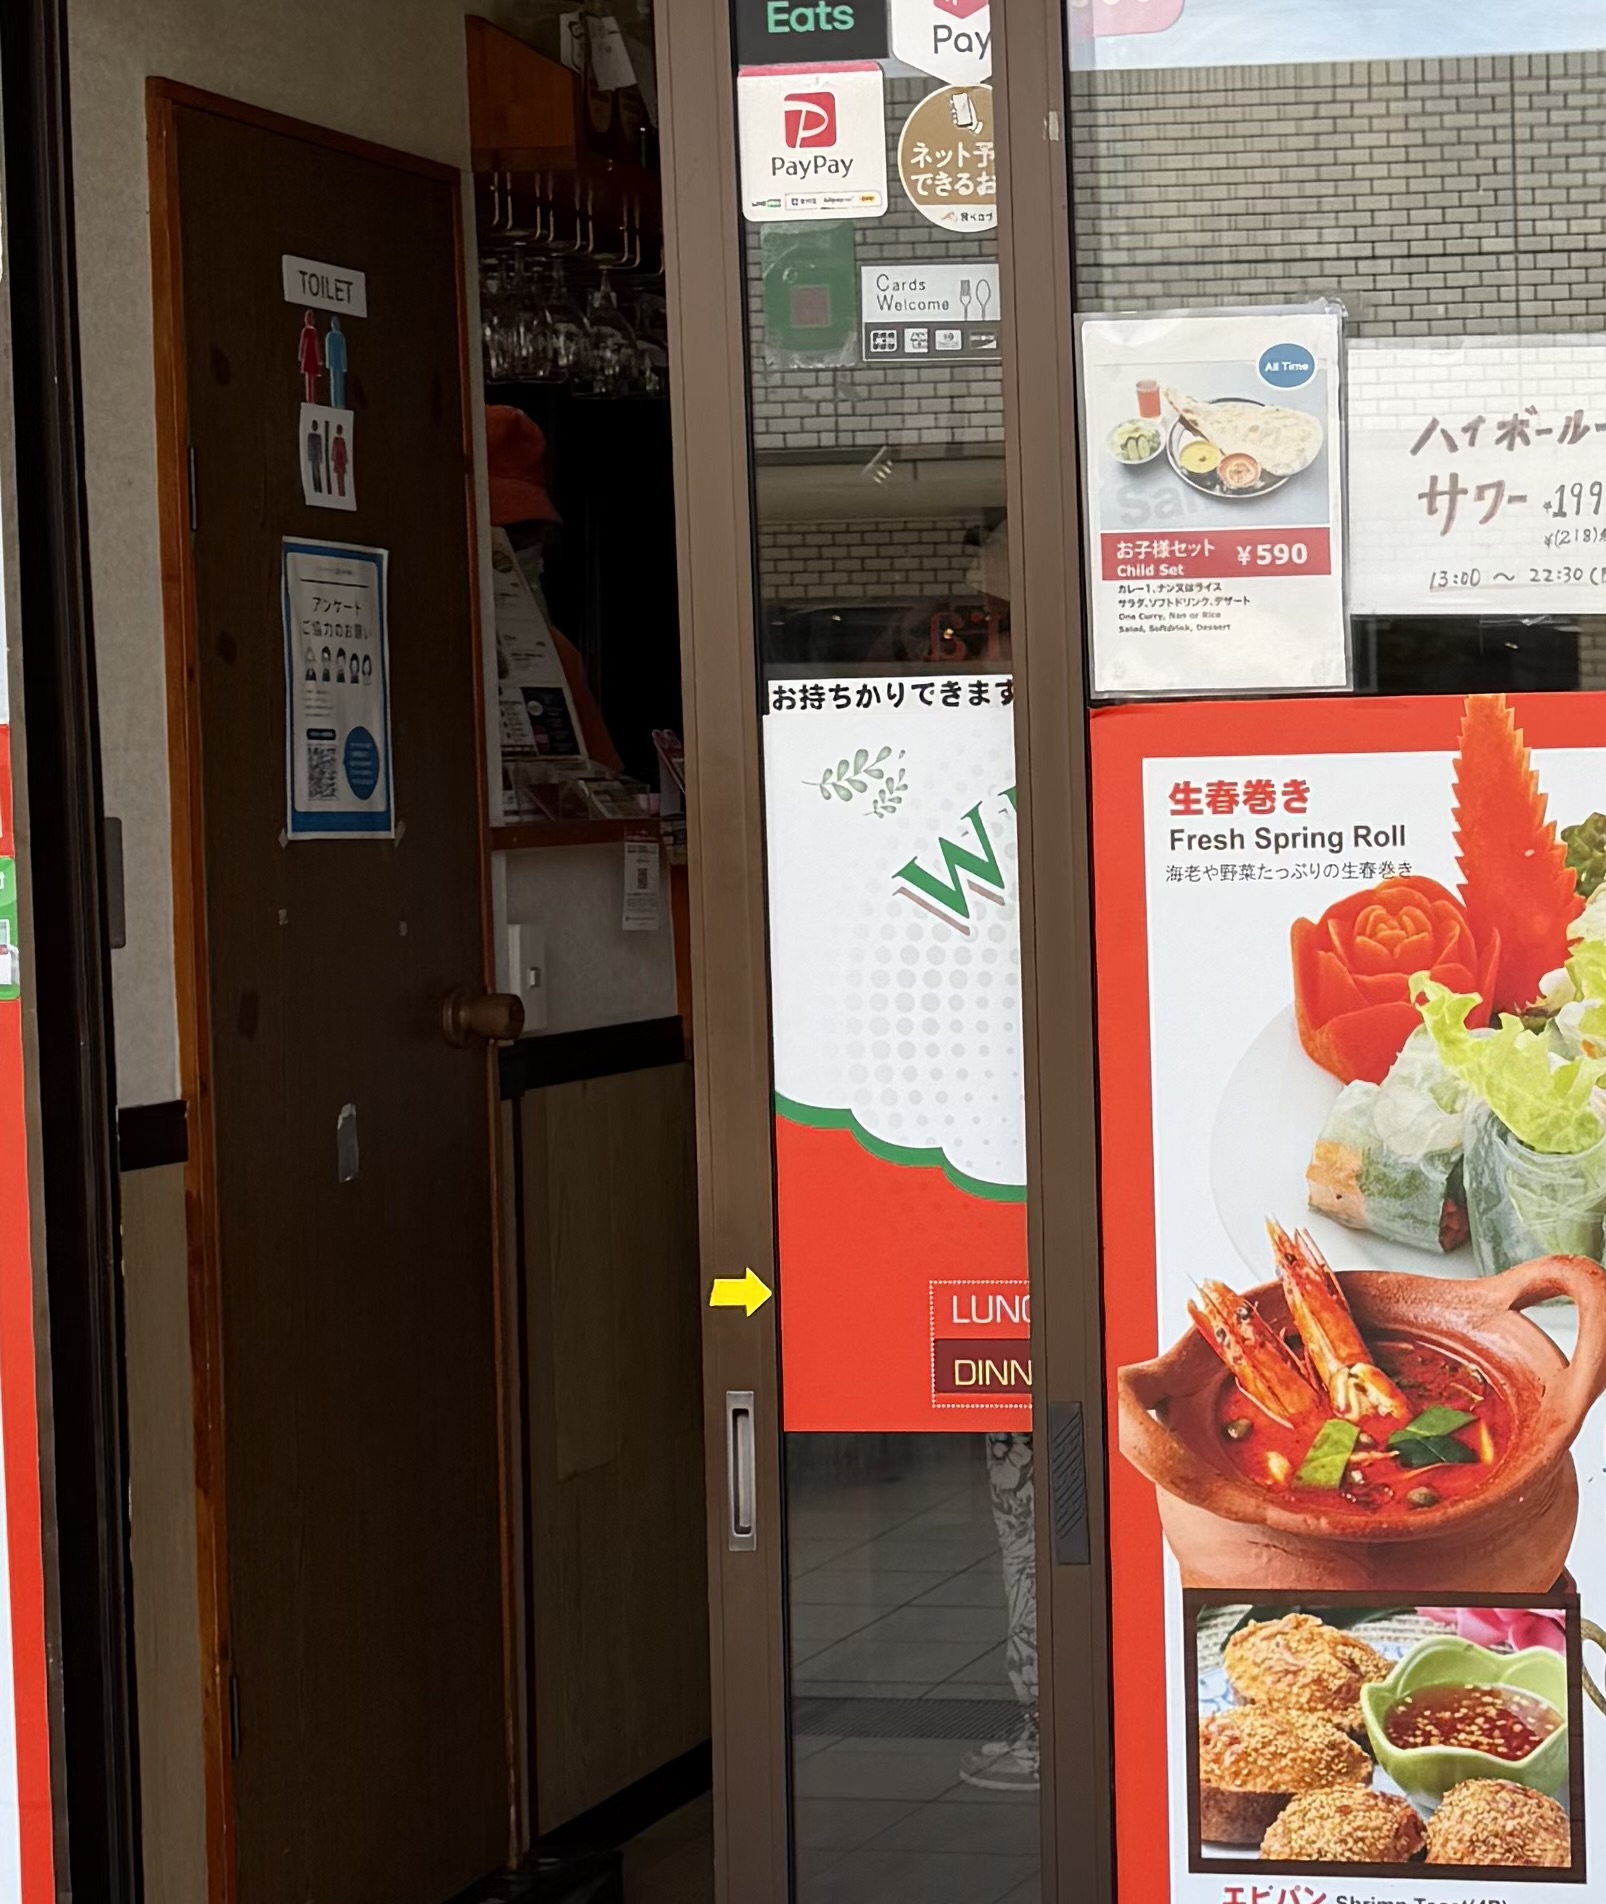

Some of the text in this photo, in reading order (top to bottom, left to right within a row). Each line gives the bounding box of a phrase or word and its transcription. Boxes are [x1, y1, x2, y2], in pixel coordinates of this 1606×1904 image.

[766, 0, 856, 34] Eats
[933, 24, 991, 61] Pay
[771, 155, 854, 180] PayPay
[298, 269, 354, 304] TOILET
[875, 273, 926, 292] Cards
[875, 294, 950, 312] Welcome
[1116, 538, 1308, 566] お子様セット ¥590
[1116, 563, 1185, 577] Child Set
[1168, 778, 1311, 817] 生春巻き
[1170, 824, 1406, 854] Fresh Spring Roll
[1165, 861, 1413, 883] 海老や野菜たっぷりの生春巻き
